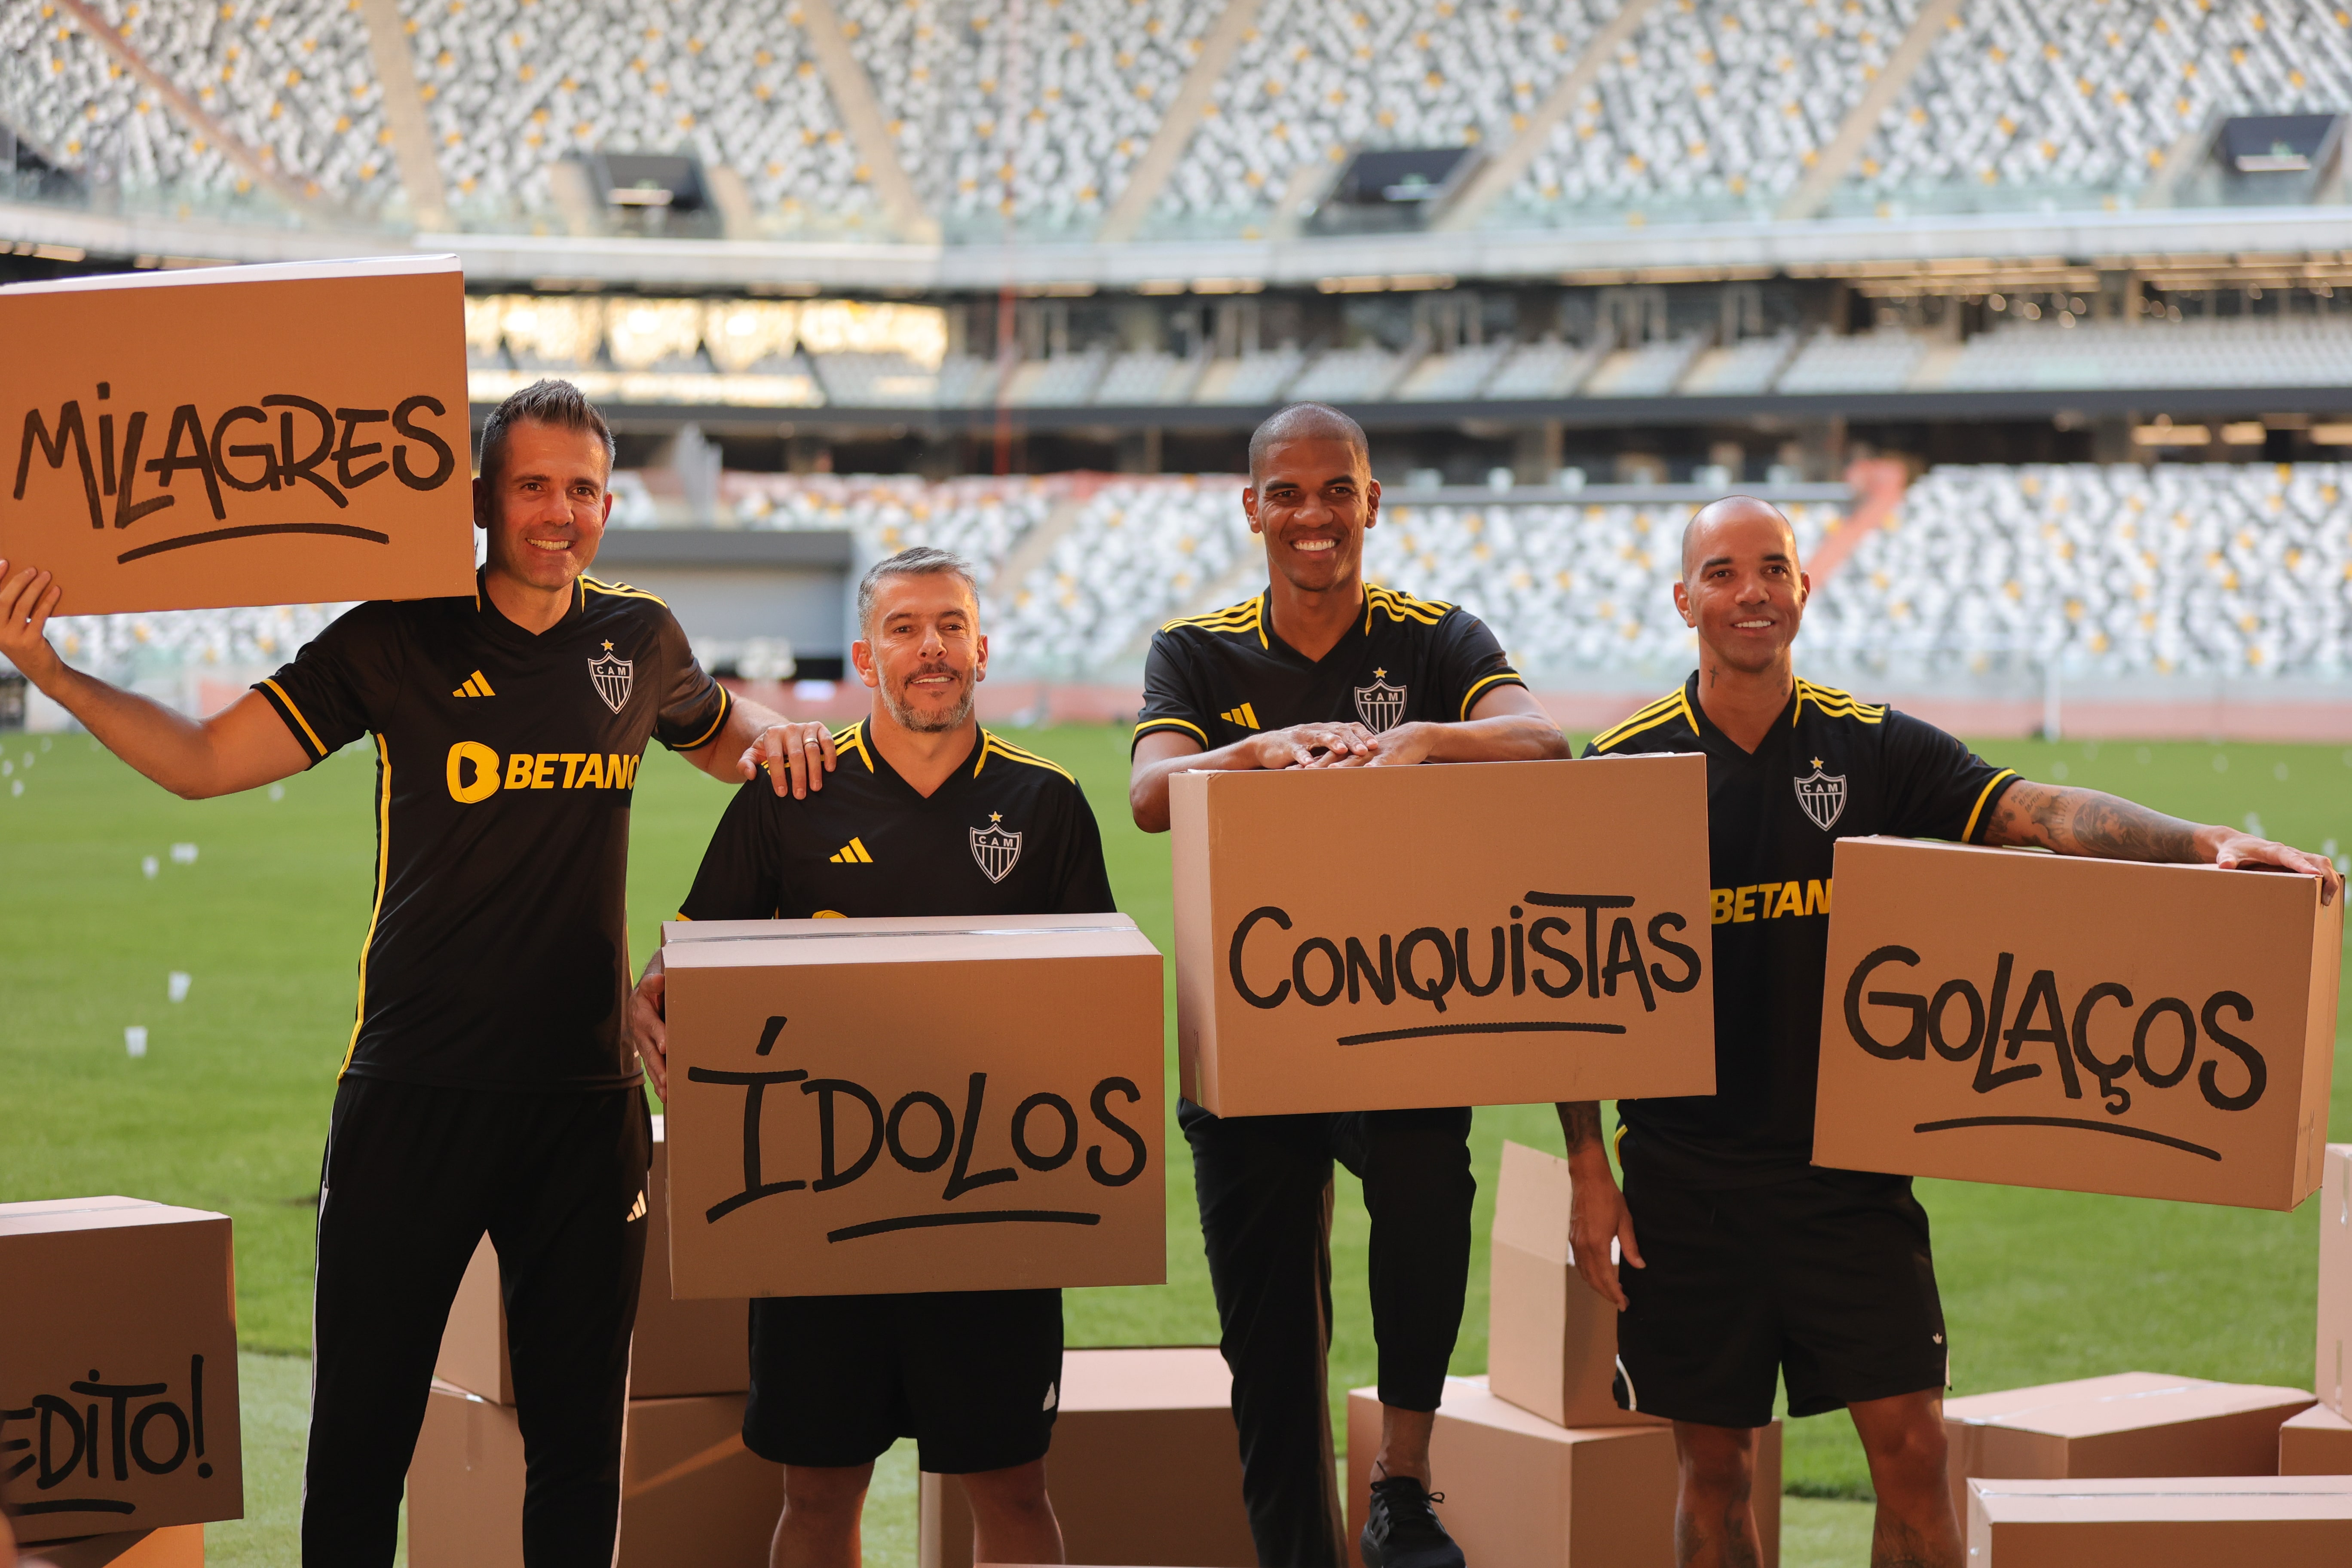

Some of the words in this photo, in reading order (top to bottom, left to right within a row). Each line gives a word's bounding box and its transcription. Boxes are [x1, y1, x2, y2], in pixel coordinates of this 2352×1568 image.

[597, 666, 627, 676] CAM
[1363, 692, 1398, 701] CAM
[503, 753, 640, 790] BETANO
[1803, 783, 1838, 793] CAM
[978, 835, 1014, 847] CAM
[1843, 944, 2267, 1116] GOLAÇOS
[687, 1015, 1147, 1225] ÍDOLOS
